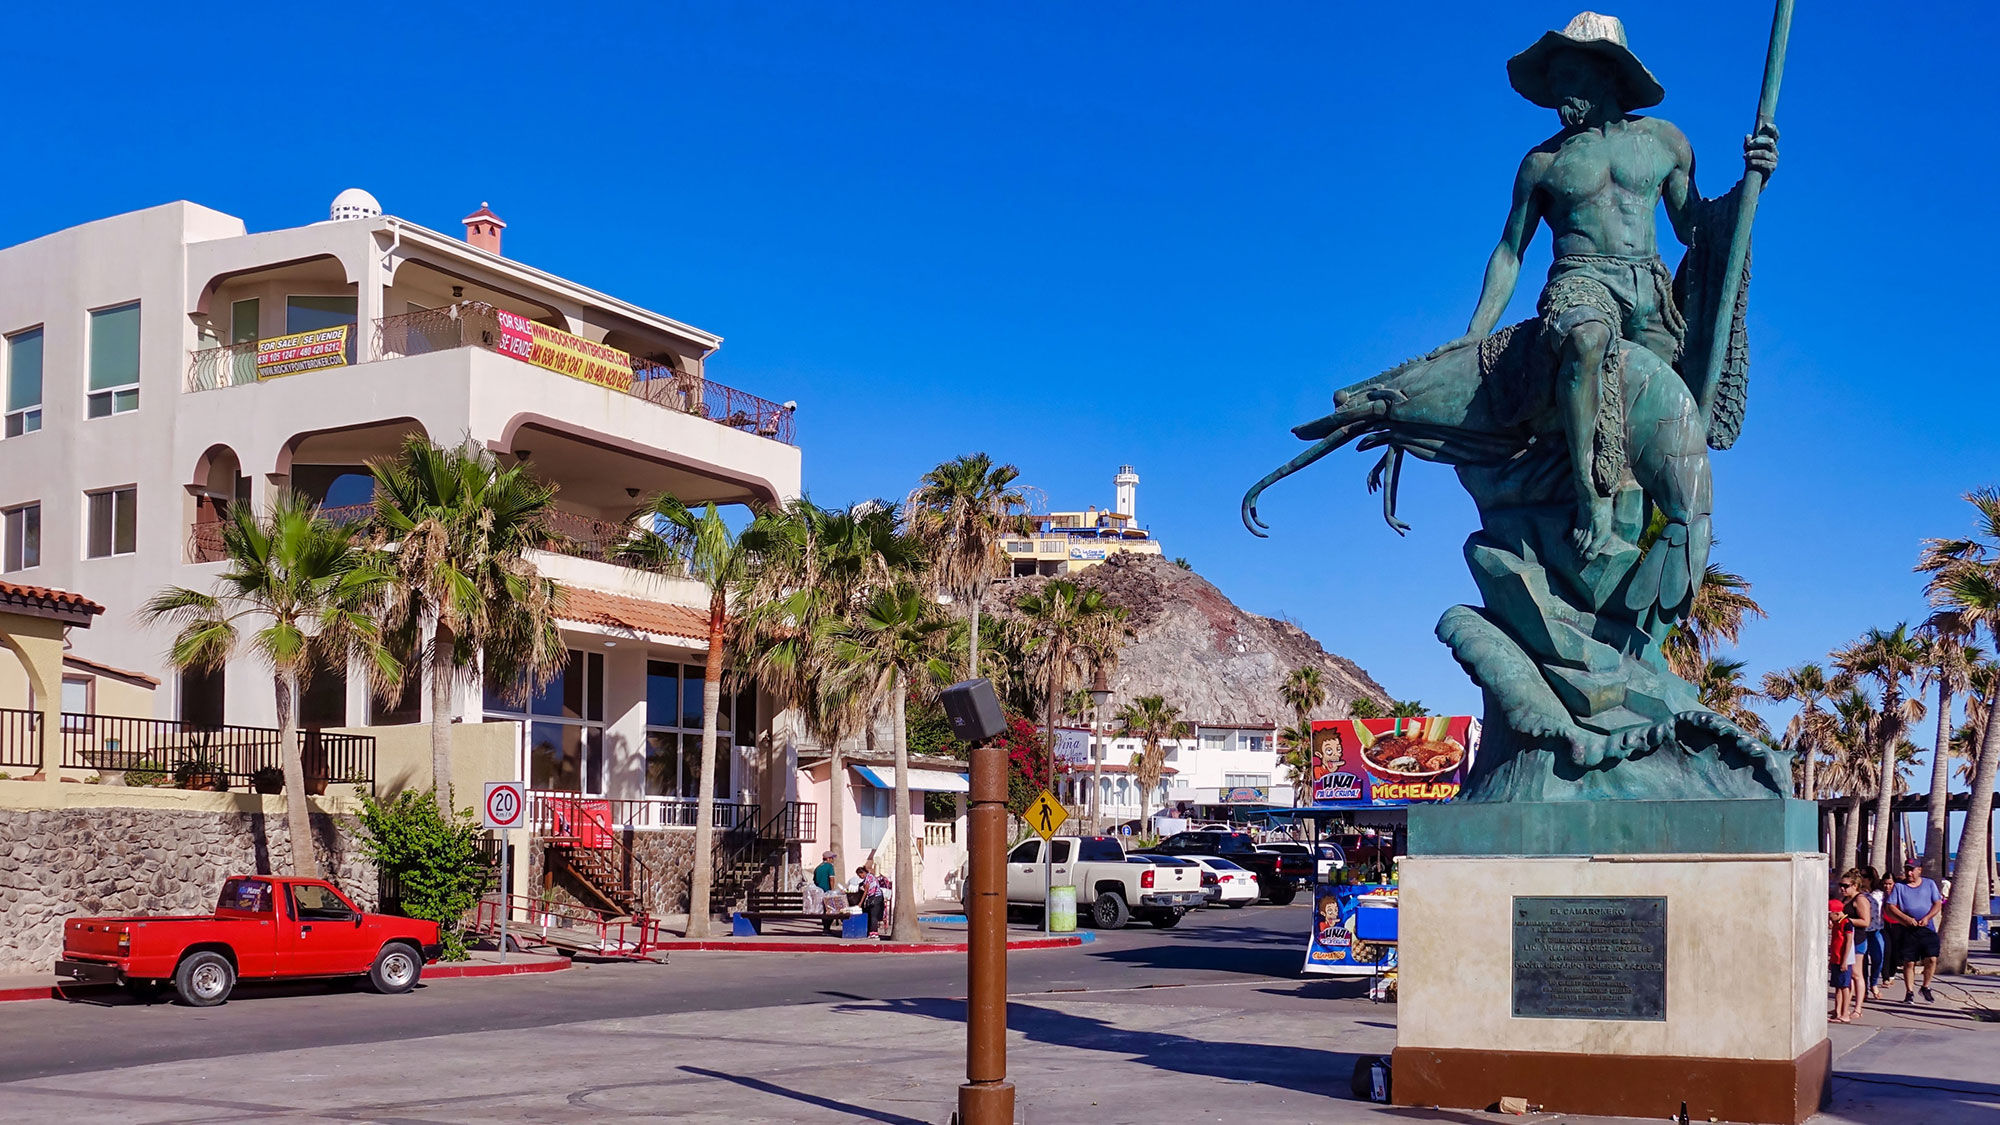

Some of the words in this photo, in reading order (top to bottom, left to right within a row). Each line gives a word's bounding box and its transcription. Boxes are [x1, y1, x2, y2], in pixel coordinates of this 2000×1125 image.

[498, 312, 515, 330] FOR
[515, 318, 533, 335] SALE
[259, 341, 276, 352] FOR
[276, 337, 299, 349] SALE
[303, 335, 313, 345] SE
[316, 329, 344, 342] VENDE
[499, 334, 510, 350] SE
[510, 337, 533, 357] VENDE
[257, 354, 269, 365] 638
[269, 352, 280, 362] 105
[282, 349, 297, 361] 1247
[312, 344, 323, 354] 420
[324, 342, 340, 352] 6212
[542, 347, 556, 367] 638
[555, 352, 568, 370] 105
[566, 355, 583, 376] 1247
[583, 359, 596, 380] US
[1323, 774, 1356, 789] UNA
[495, 793, 513, 812] 20
[1326, 790, 1335, 798] LA
[1335, 788, 1360, 798] CRUDA!
[1550, 908, 1562, 916] EL
[1563, 907, 1626, 917] CAMARONERO
[1325, 928, 1346, 939] UNA
